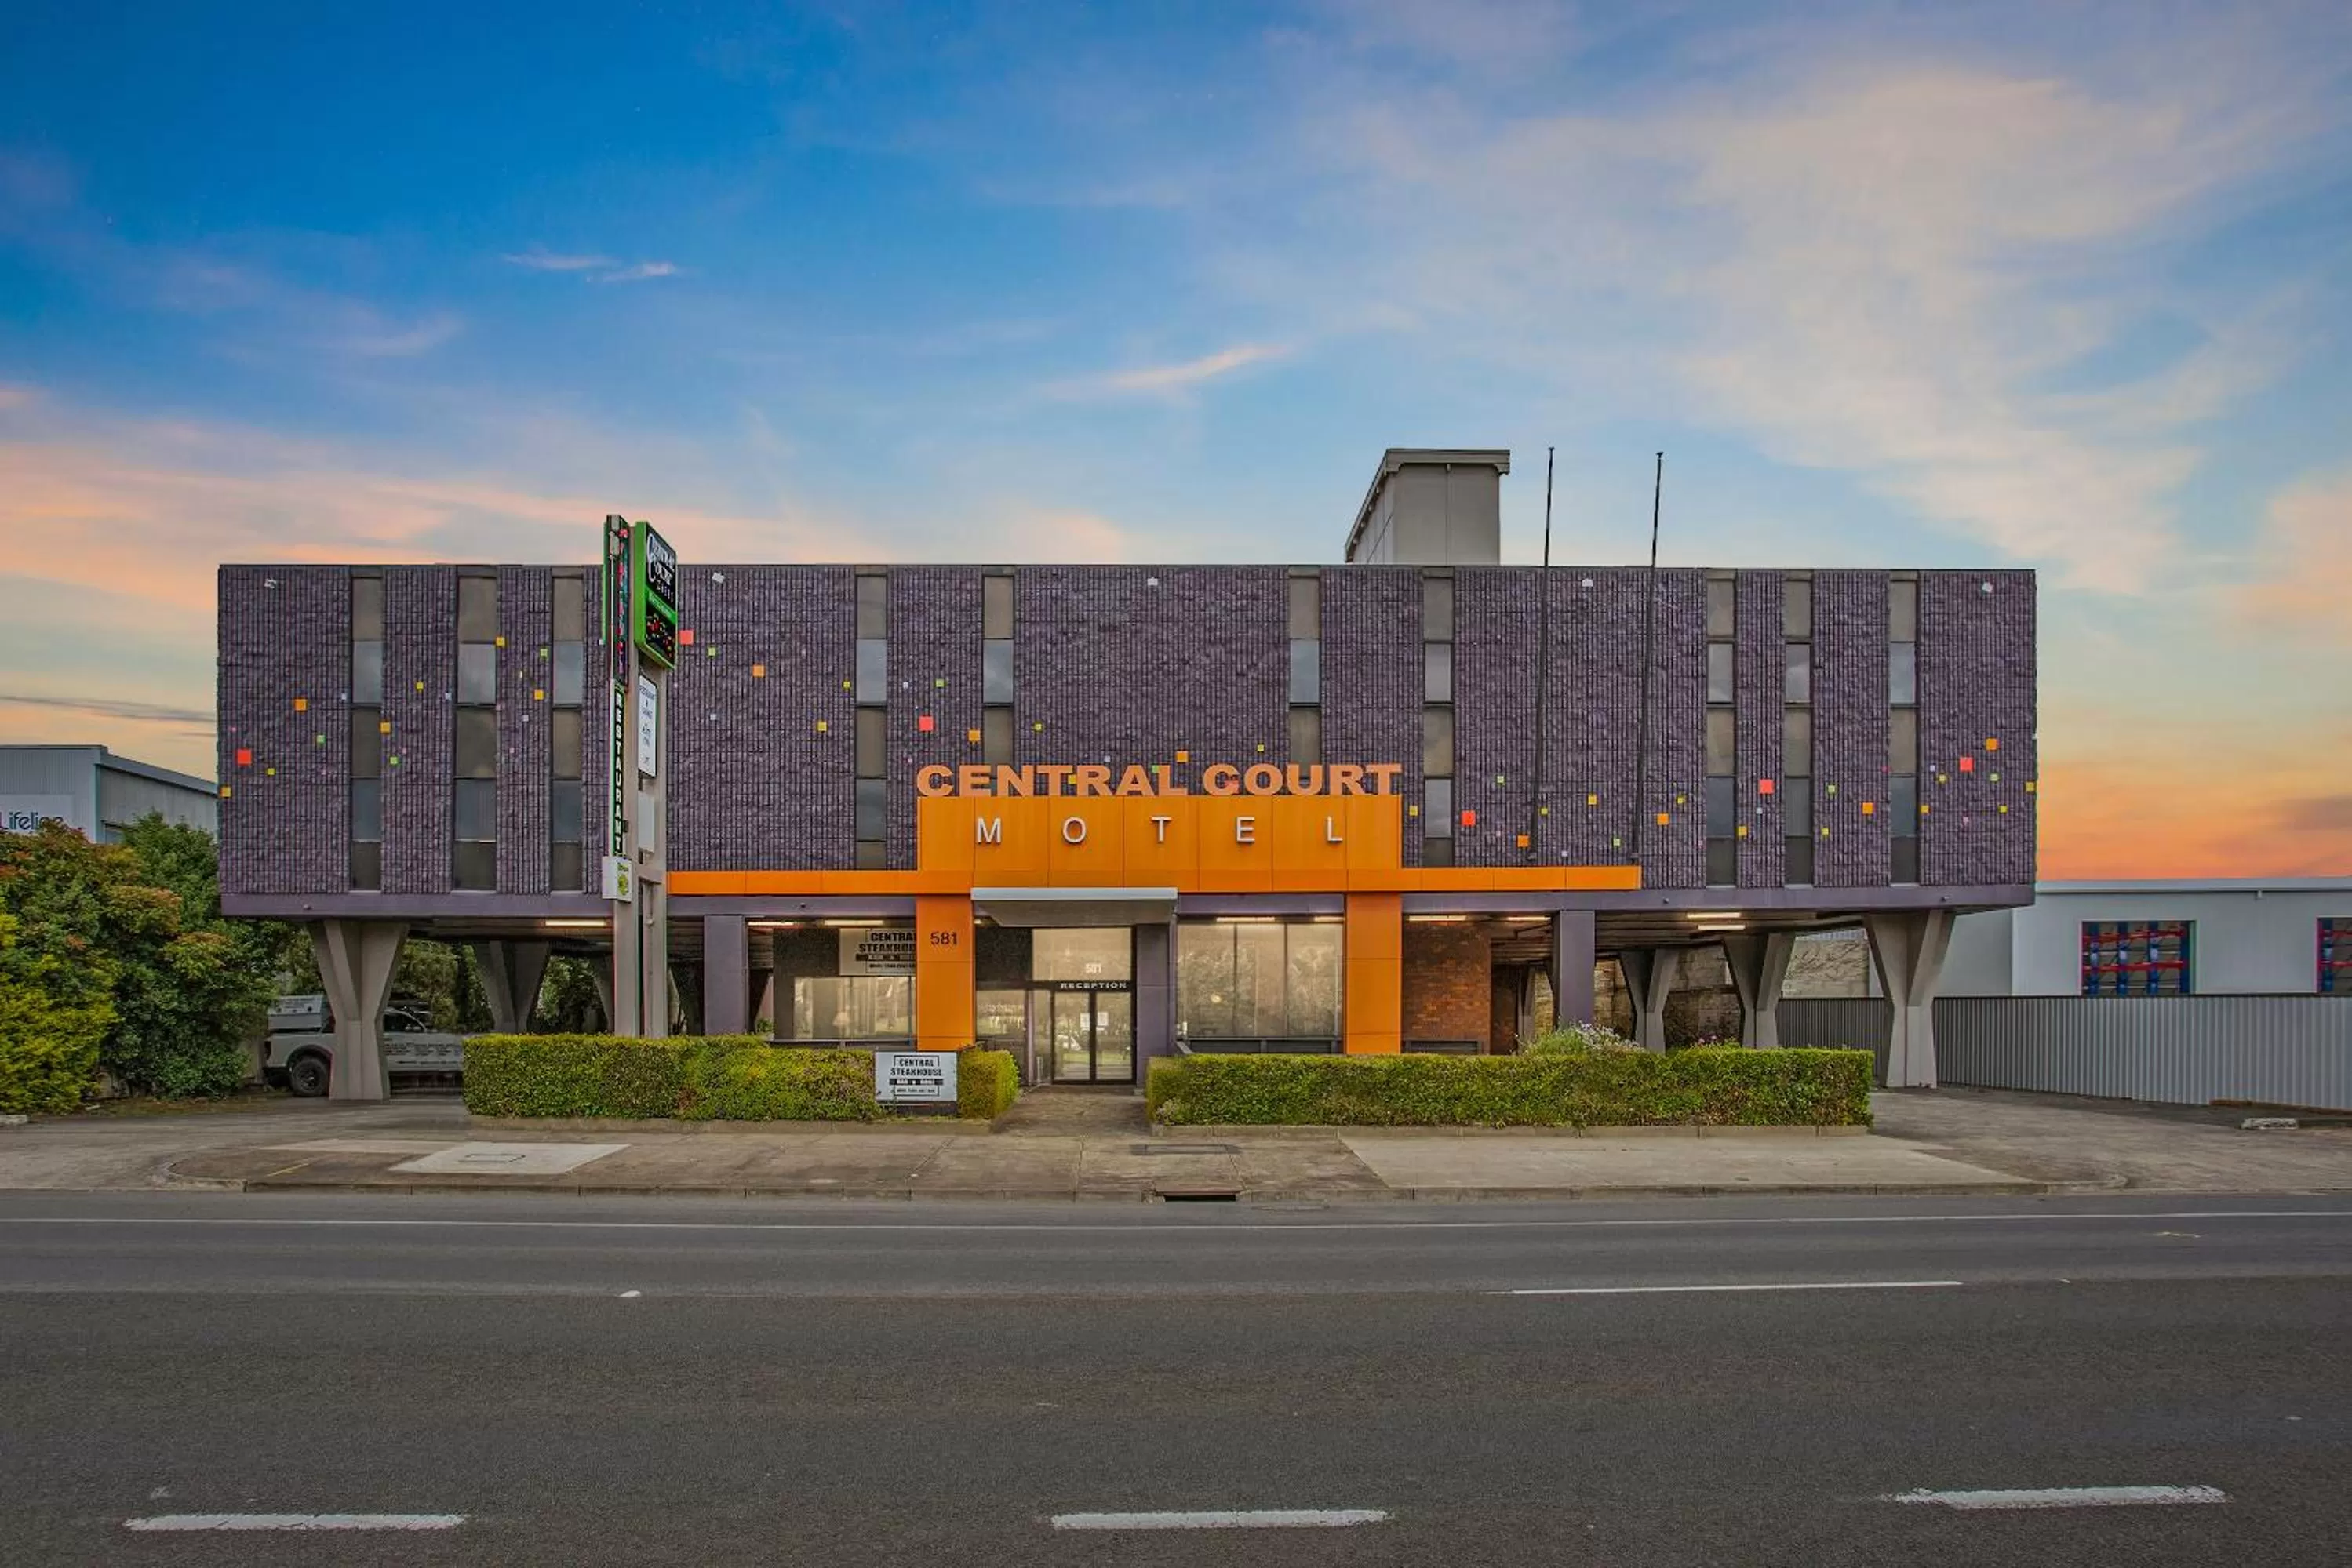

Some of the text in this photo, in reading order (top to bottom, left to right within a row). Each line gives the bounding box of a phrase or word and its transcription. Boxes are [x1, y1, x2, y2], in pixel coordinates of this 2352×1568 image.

[614, 692, 623, 853] RESTAURANT
[916, 763, 1402, 796] CENTRAL COURT
[976, 816, 1342, 844] MOTEL
[930, 931, 957, 944] 581
[890, 1068, 942, 1076] STEAKHOUSE
